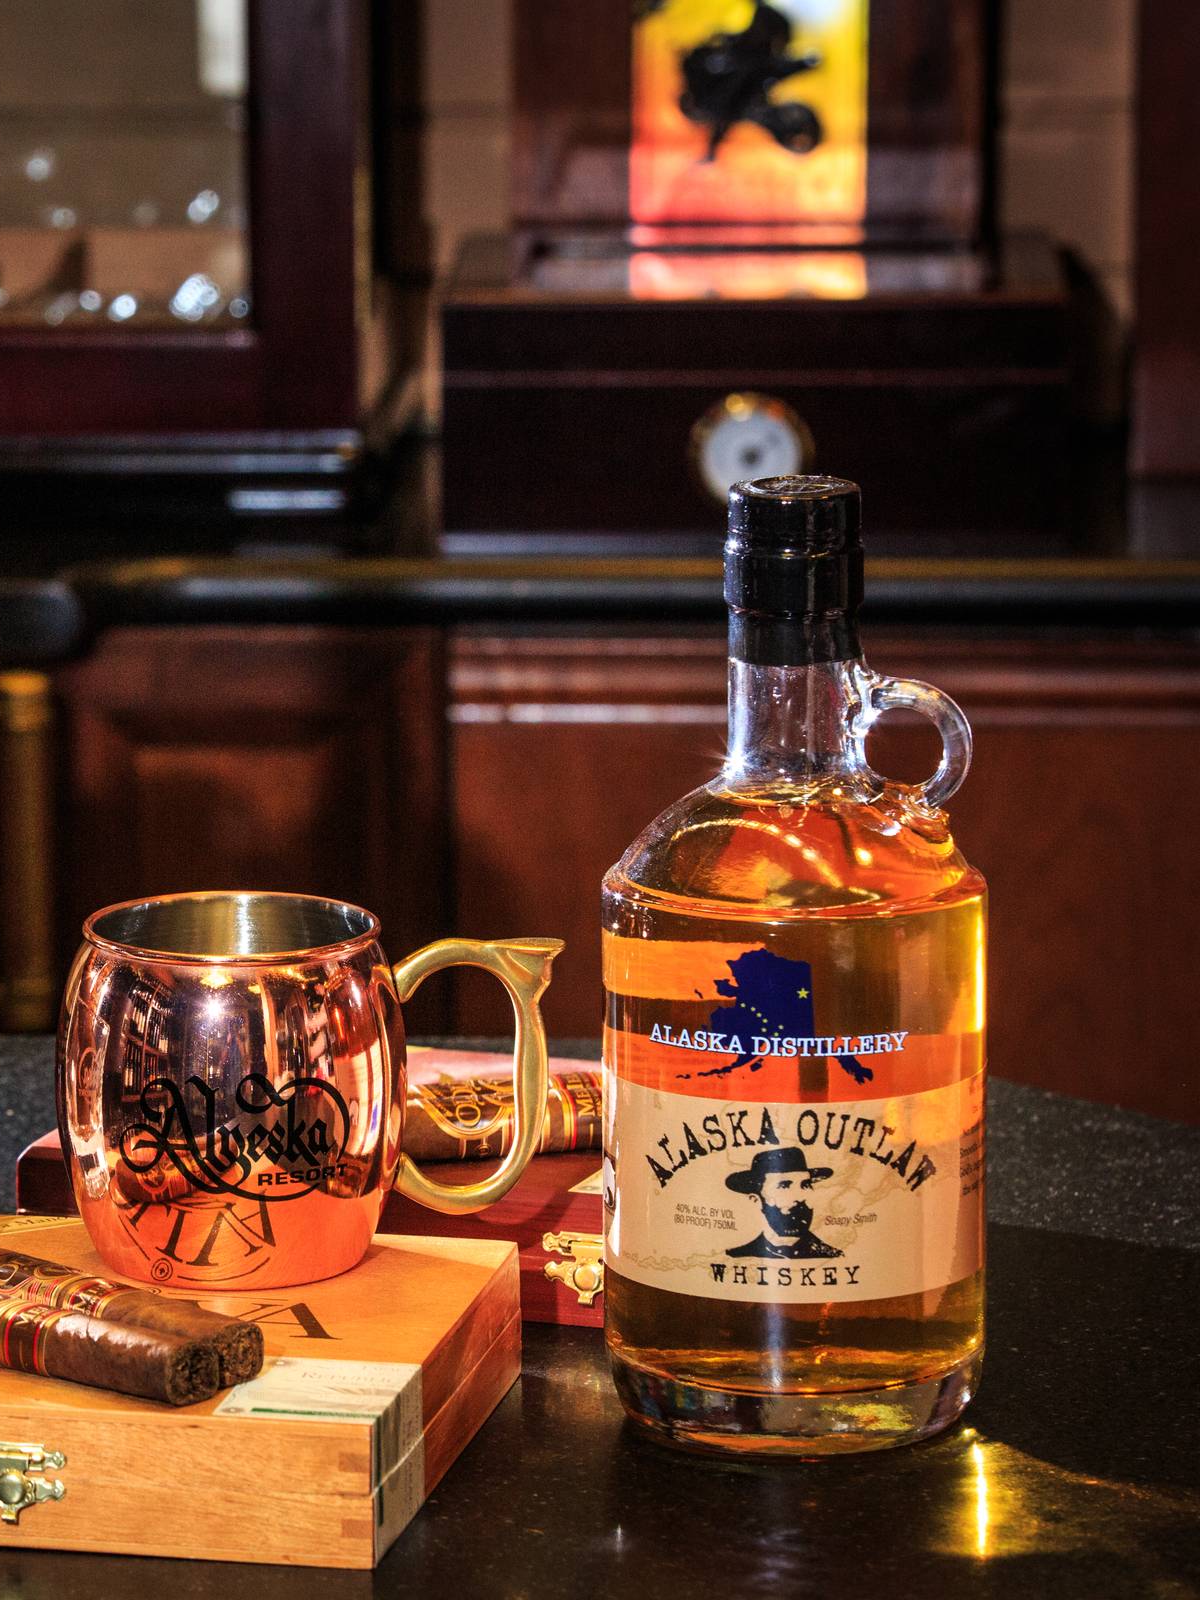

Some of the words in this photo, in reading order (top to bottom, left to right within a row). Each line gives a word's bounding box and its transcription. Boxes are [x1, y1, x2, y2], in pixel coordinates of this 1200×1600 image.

[649, 1022, 747, 1056] ALASKA
[751, 1030, 909, 1058] DISTILLERY
[645, 1106, 780, 1188] ALASKA
[796, 1109, 937, 1192] OUTLAW
[257, 1163, 348, 1187] RESORT
[676, 1203, 691, 1214] 40%
[710, 1207, 719, 1218] BY
[685, 1215, 711, 1229] PROOF)
[712, 1219, 739, 1231] 750ML
[710, 1262, 861, 1287] WHISKEY
